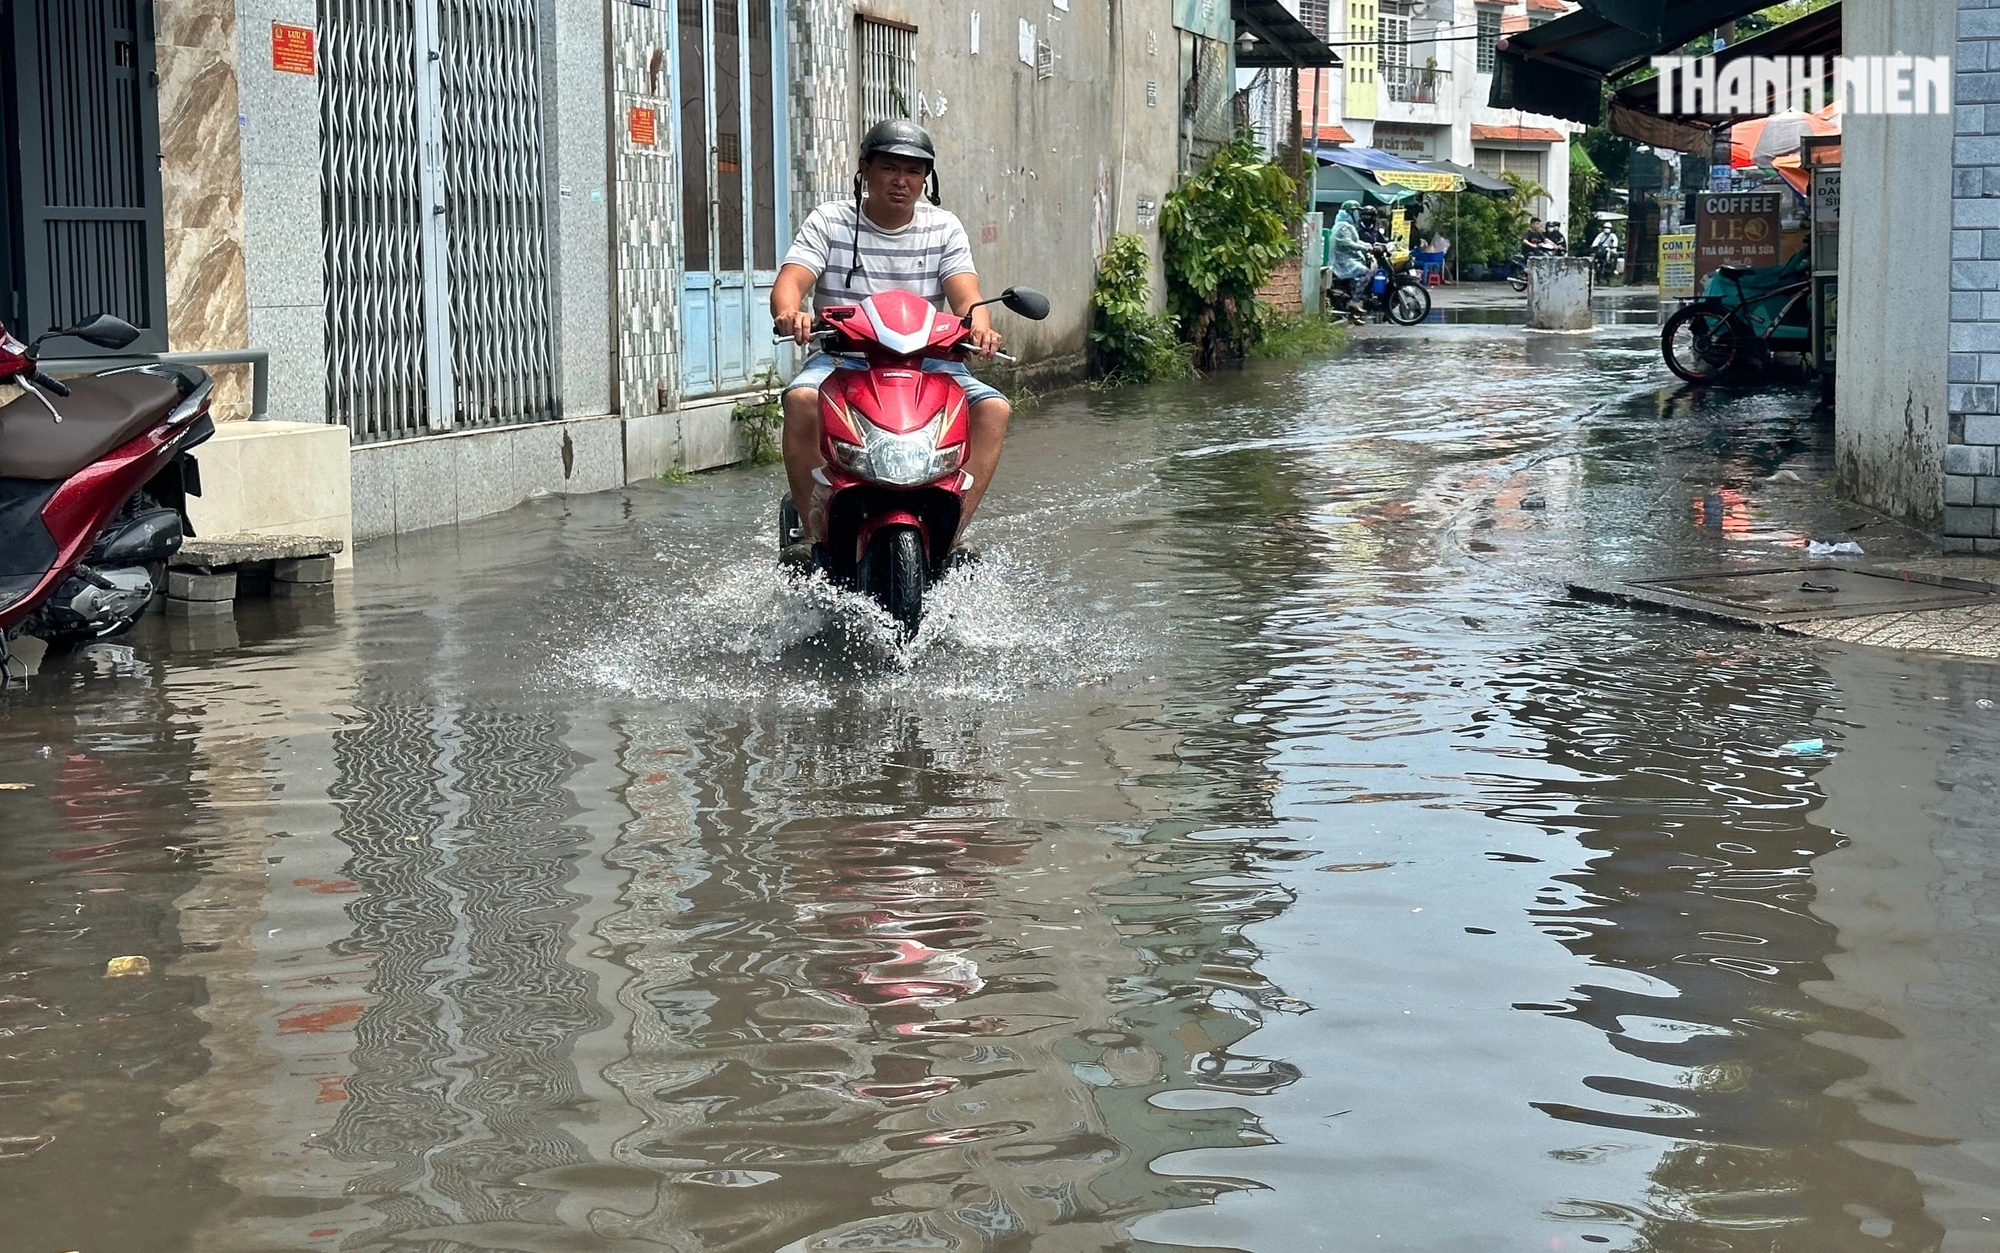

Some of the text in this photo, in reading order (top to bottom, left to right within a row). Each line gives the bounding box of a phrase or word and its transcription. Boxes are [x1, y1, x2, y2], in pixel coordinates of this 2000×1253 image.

[1706, 197, 1773, 214] COFFEE
[1662, 240, 1683, 250] CƠM
[1701, 245, 1717, 256] TRÀ
[1718, 244, 1735, 255] ĐÀO
[1741, 244, 1757, 255] TRÀ
[1758, 243, 1775, 255] SỮA
